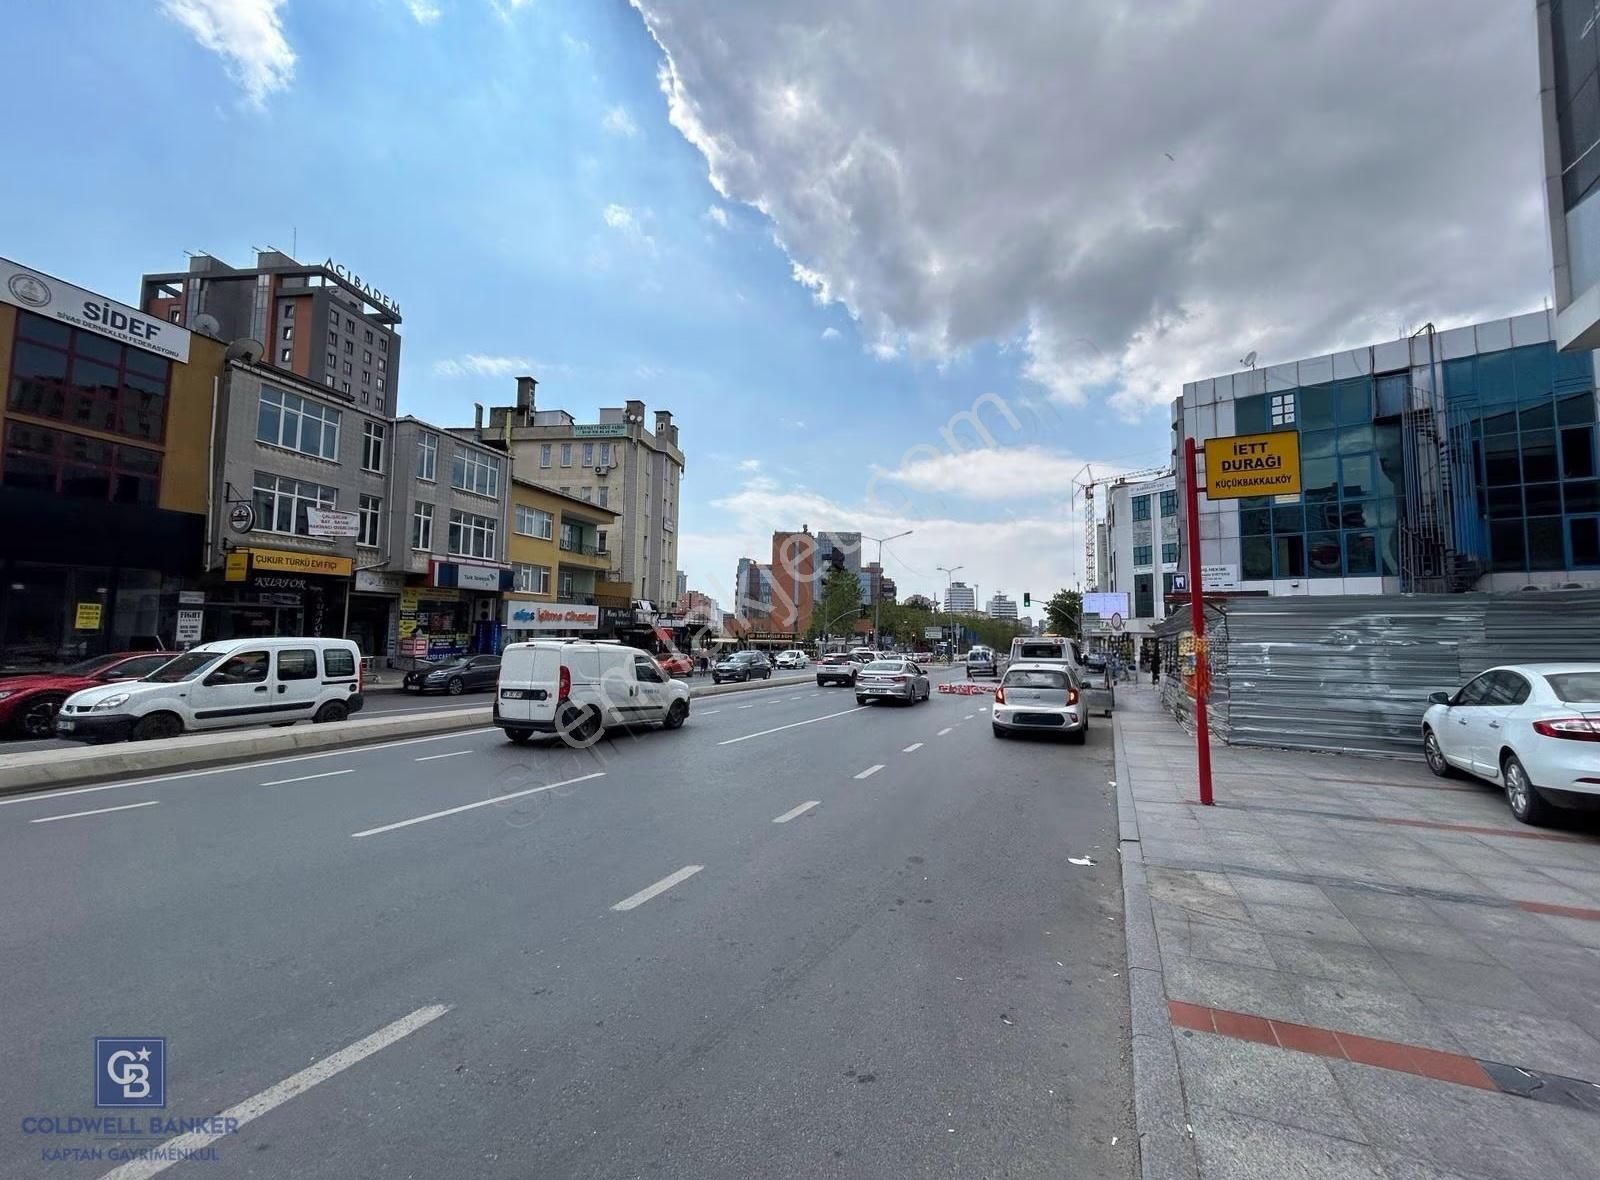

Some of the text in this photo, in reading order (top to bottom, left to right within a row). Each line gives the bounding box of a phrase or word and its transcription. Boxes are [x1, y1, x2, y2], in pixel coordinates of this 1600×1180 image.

[324, 257, 400, 314] ACIBADEM
[82, 301, 161, 340] SİDEF
[1233, 442, 1268, 456] İETT
[1222, 454, 1282, 471] DURAĞI
[256, 555, 283, 565] ÇUKUR
